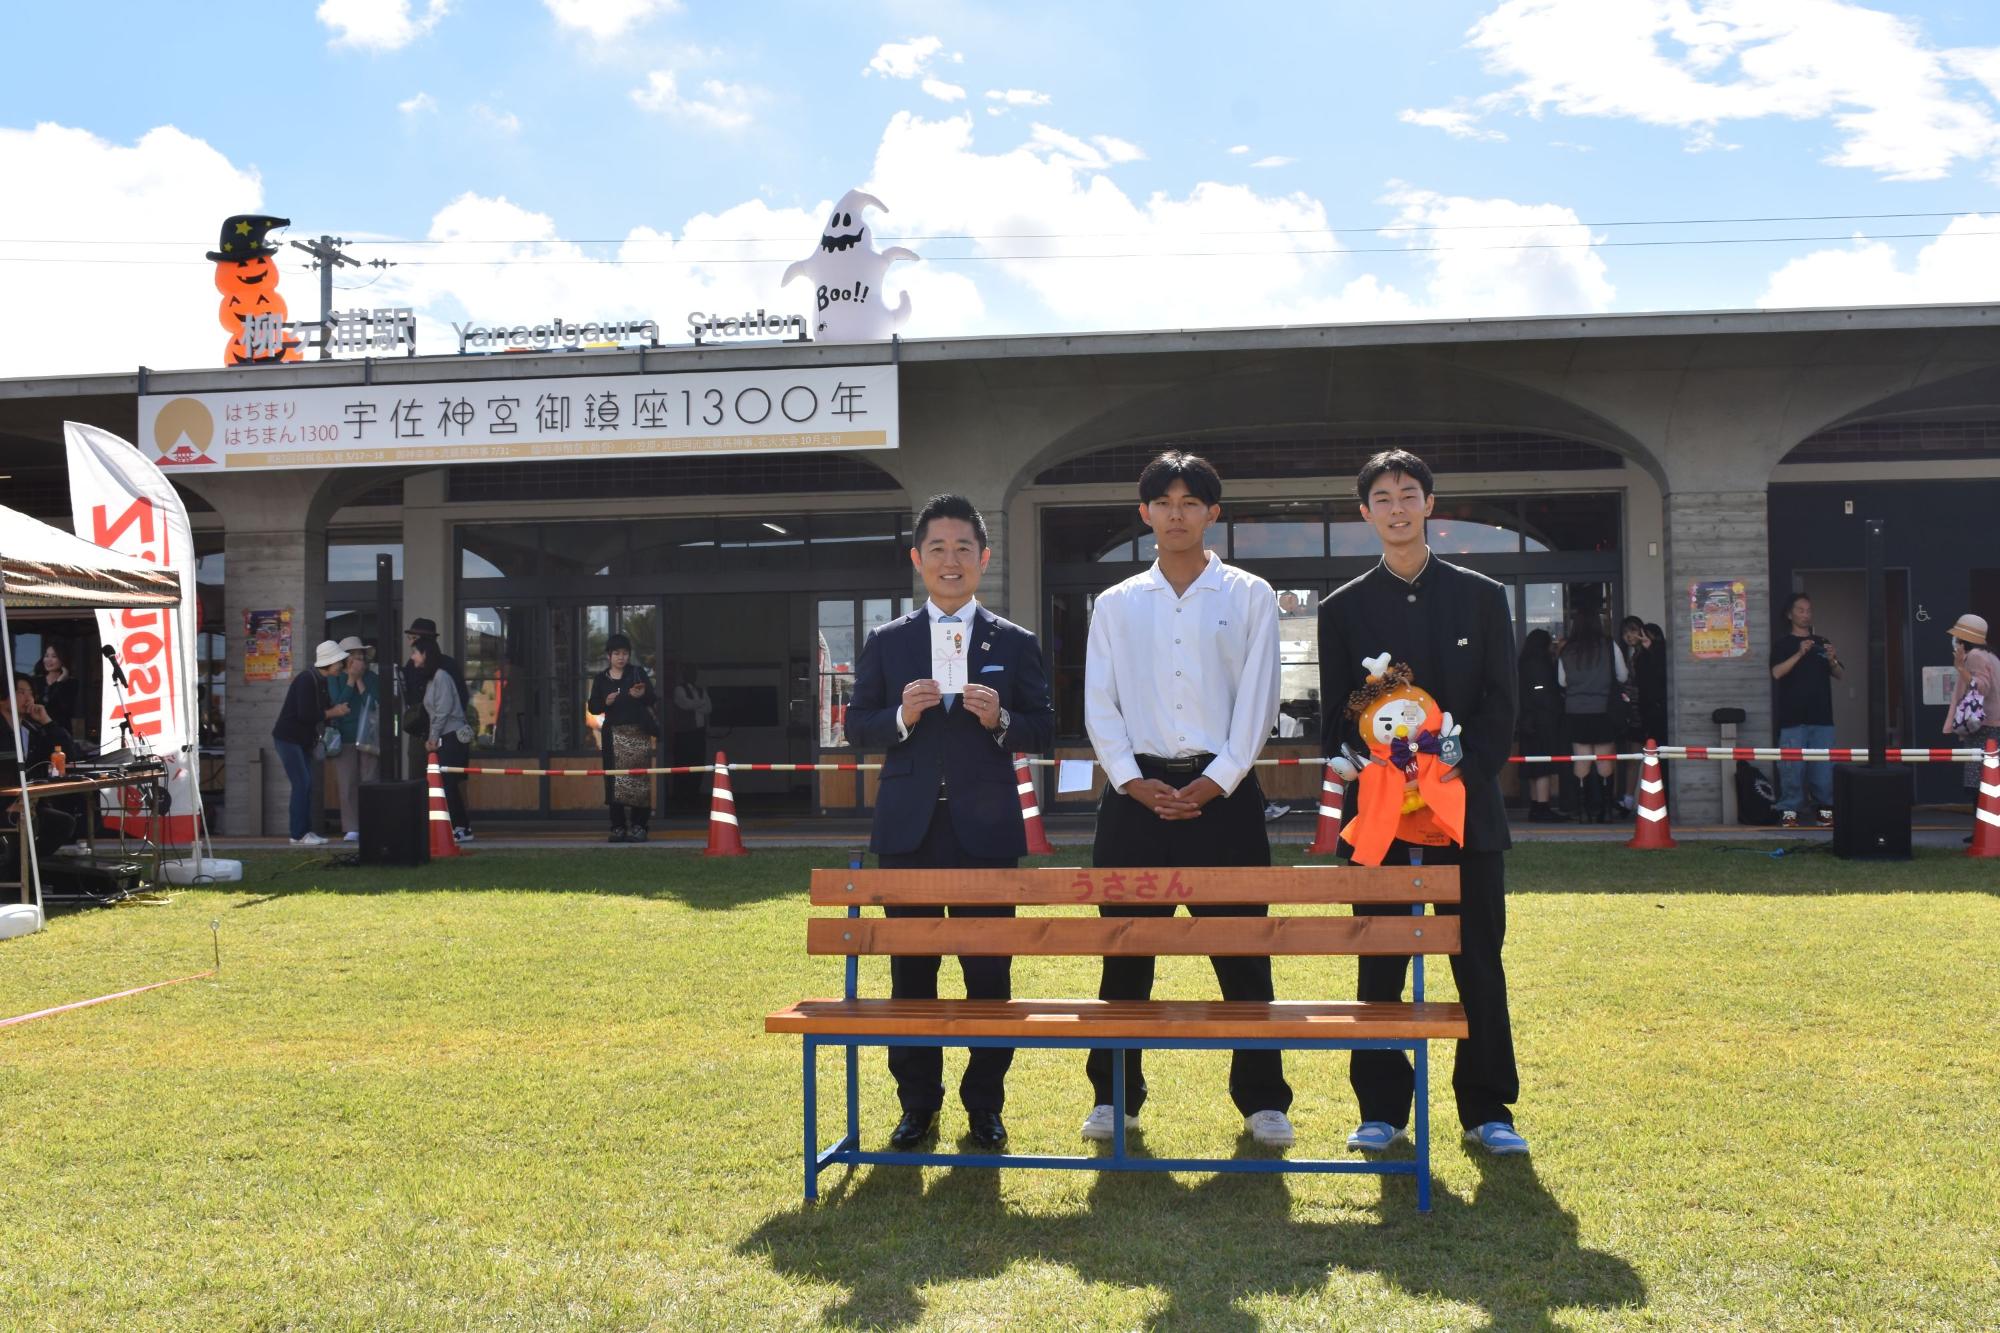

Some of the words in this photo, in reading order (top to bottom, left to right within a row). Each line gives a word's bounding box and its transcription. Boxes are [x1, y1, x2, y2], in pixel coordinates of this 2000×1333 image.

[817, 281, 869, 312] Boo!!
[451, 318, 656, 348] Yanagigaura
[687, 310, 806, 339] Station
[225, 401, 297, 422] はぢまり
[342, 381, 868, 440] 宇佐神宮御鎮座1300年
[225, 424, 339, 446] はちまん1300
[1071, 871, 1194, 901] うささん
